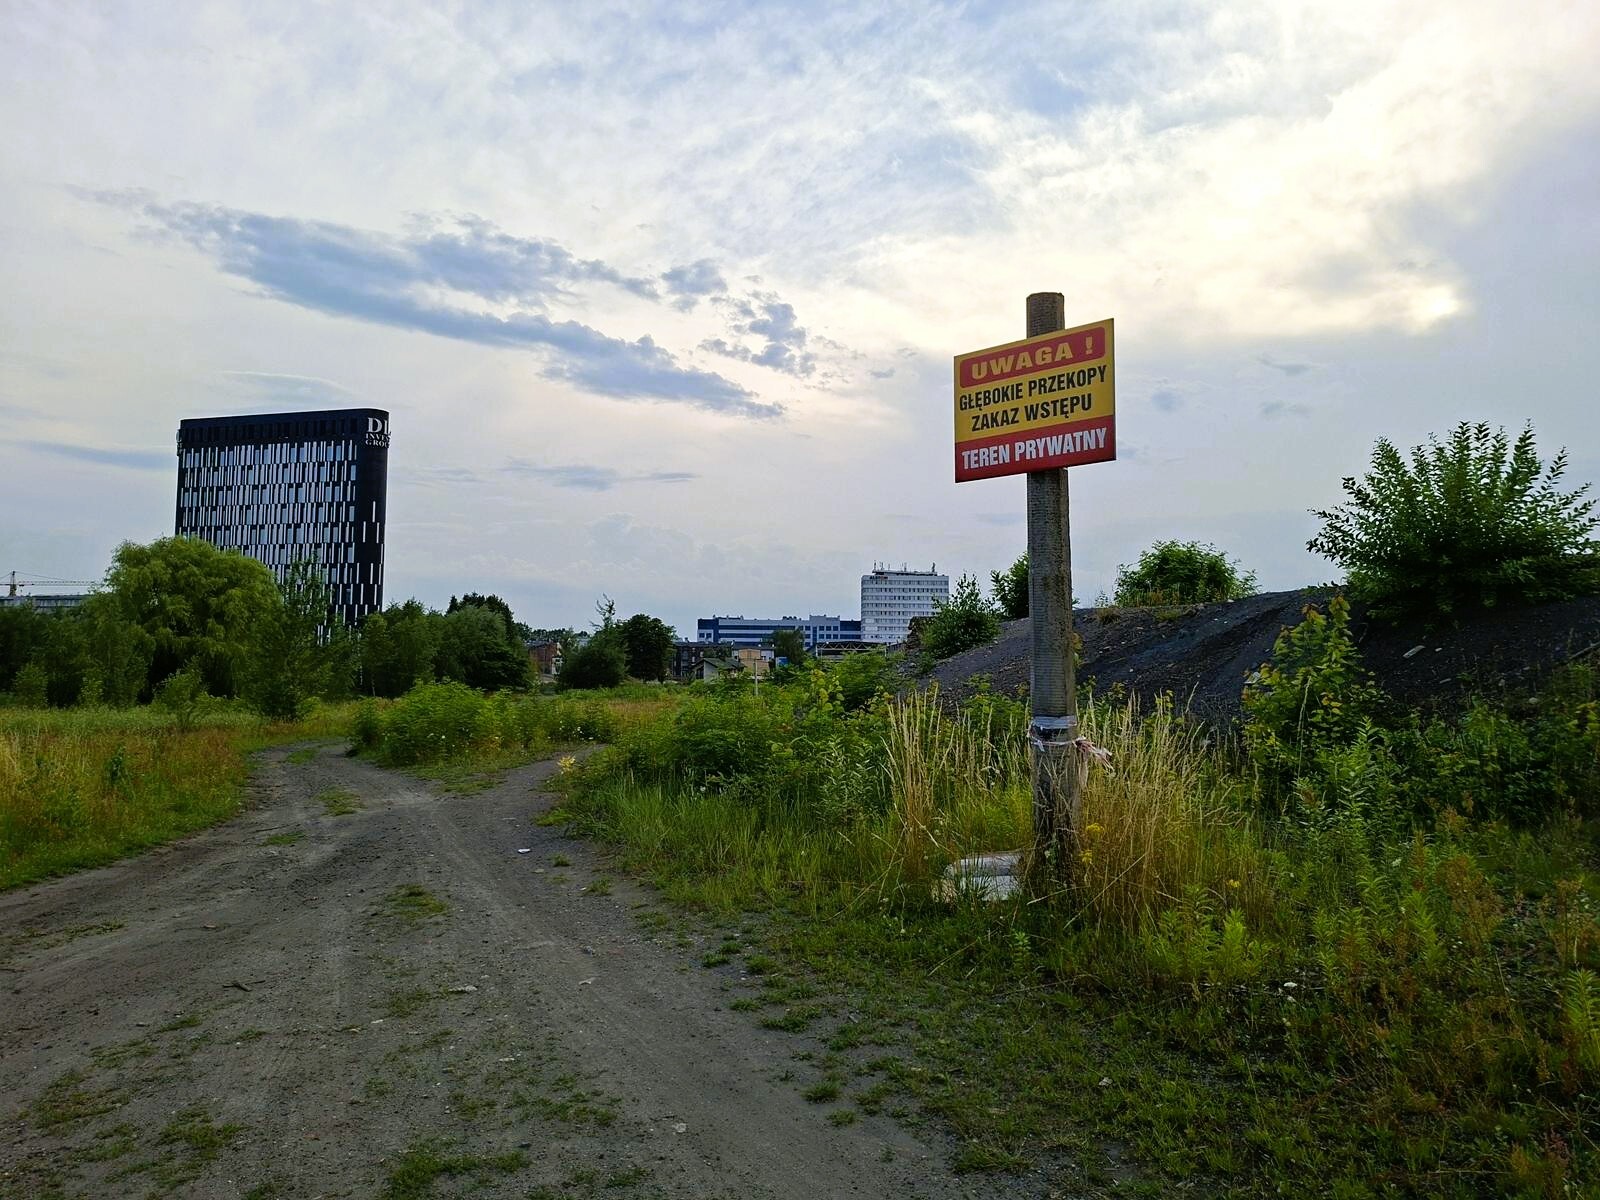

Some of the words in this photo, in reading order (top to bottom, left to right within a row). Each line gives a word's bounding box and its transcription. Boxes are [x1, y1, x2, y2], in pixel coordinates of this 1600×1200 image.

[971, 342, 1073, 380] UWAGA
[1085, 336, 1093, 355] !
[959, 383, 1023, 411] GŁĘBOKIE
[1028, 364, 1107, 397] PRZEKOPY
[971, 408, 1020, 432] ZAKAZ
[1024, 393, 1092, 421] WSTĘPU
[961, 444, 1010, 470] TEREN
[1015, 427, 1107, 462] PRYWATNY
